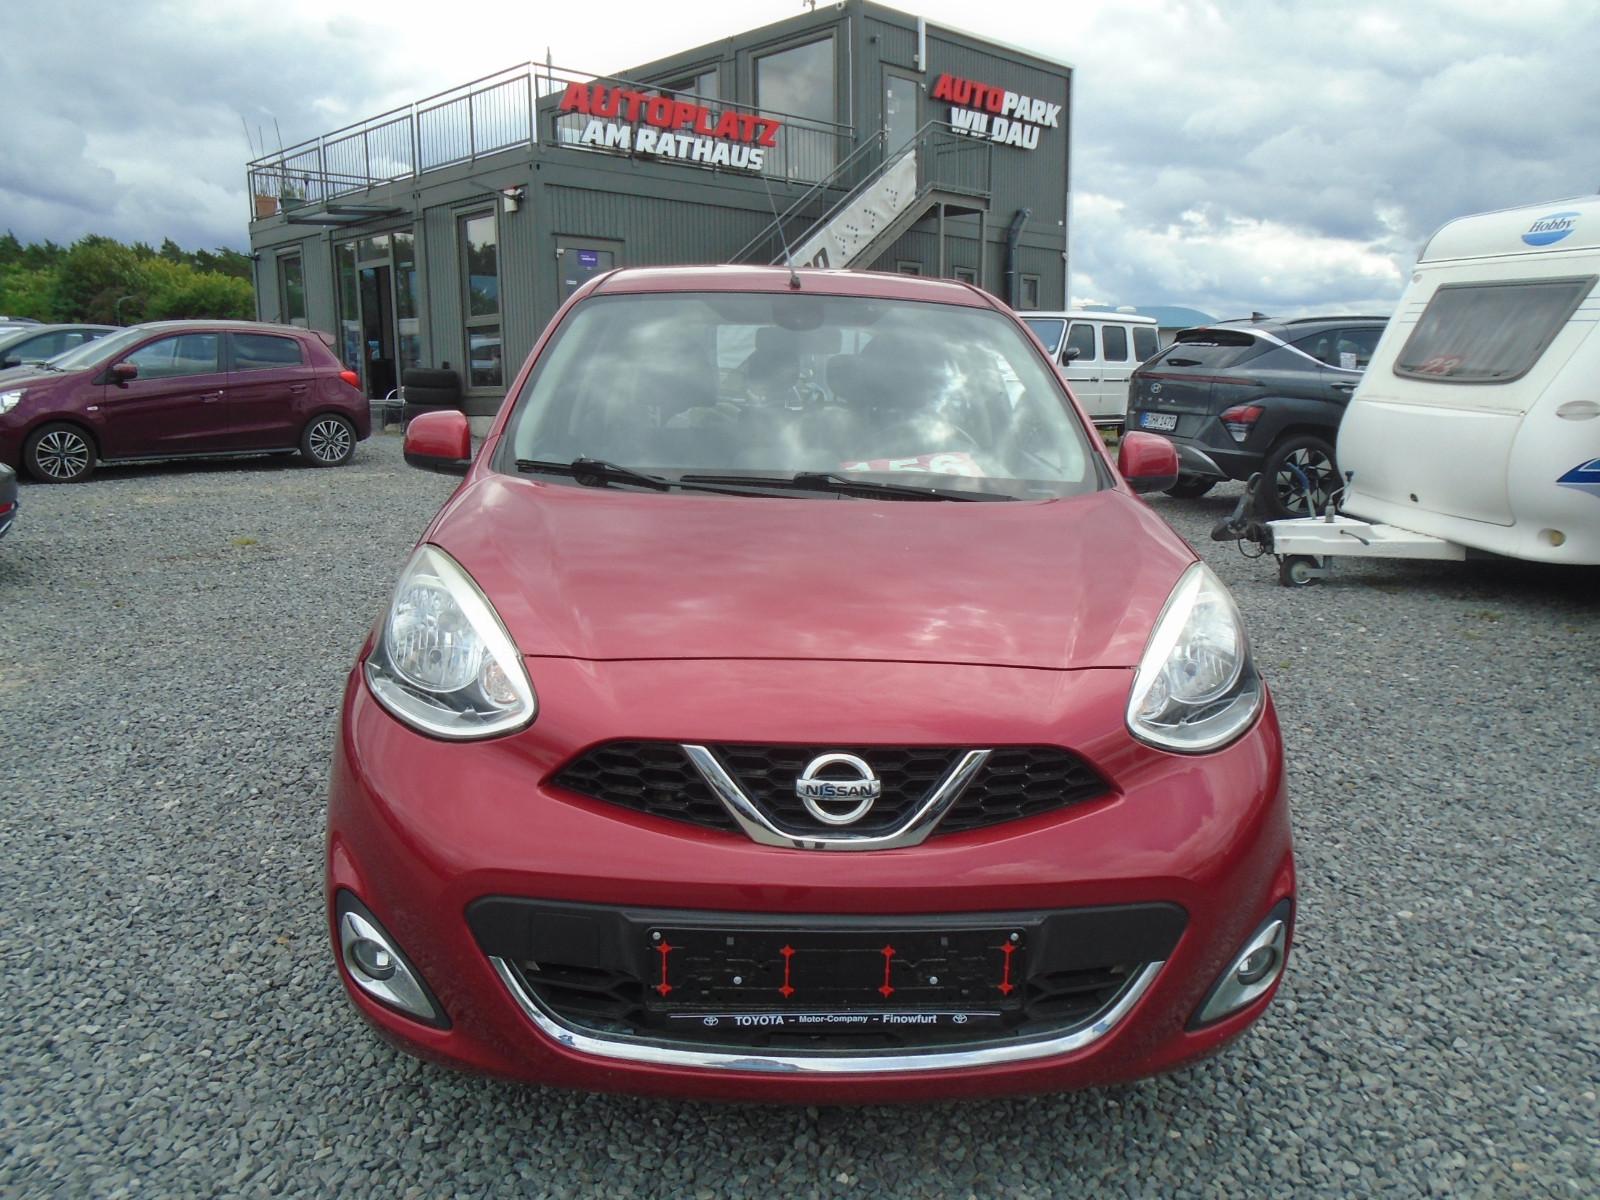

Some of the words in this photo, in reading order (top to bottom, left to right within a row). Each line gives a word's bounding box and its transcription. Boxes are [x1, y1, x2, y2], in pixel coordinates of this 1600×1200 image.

[559, 81, 782, 147] AUTOPLATZ
[933, 73, 1062, 128] AUTOPARK
[581, 119, 632, 149] AM
[635, 128, 766, 171] RATHAUS
[951, 107, 1040, 150] WILDAU
[1529, 218, 1572, 233] Hobby
[805, 784, 873, 797] NISSAN
[735, 1016, 785, 1026] TOYOTA
[799, 1014, 869, 1024] Motor-Company
[882, 1014, 937, 1024] Finowfurt
